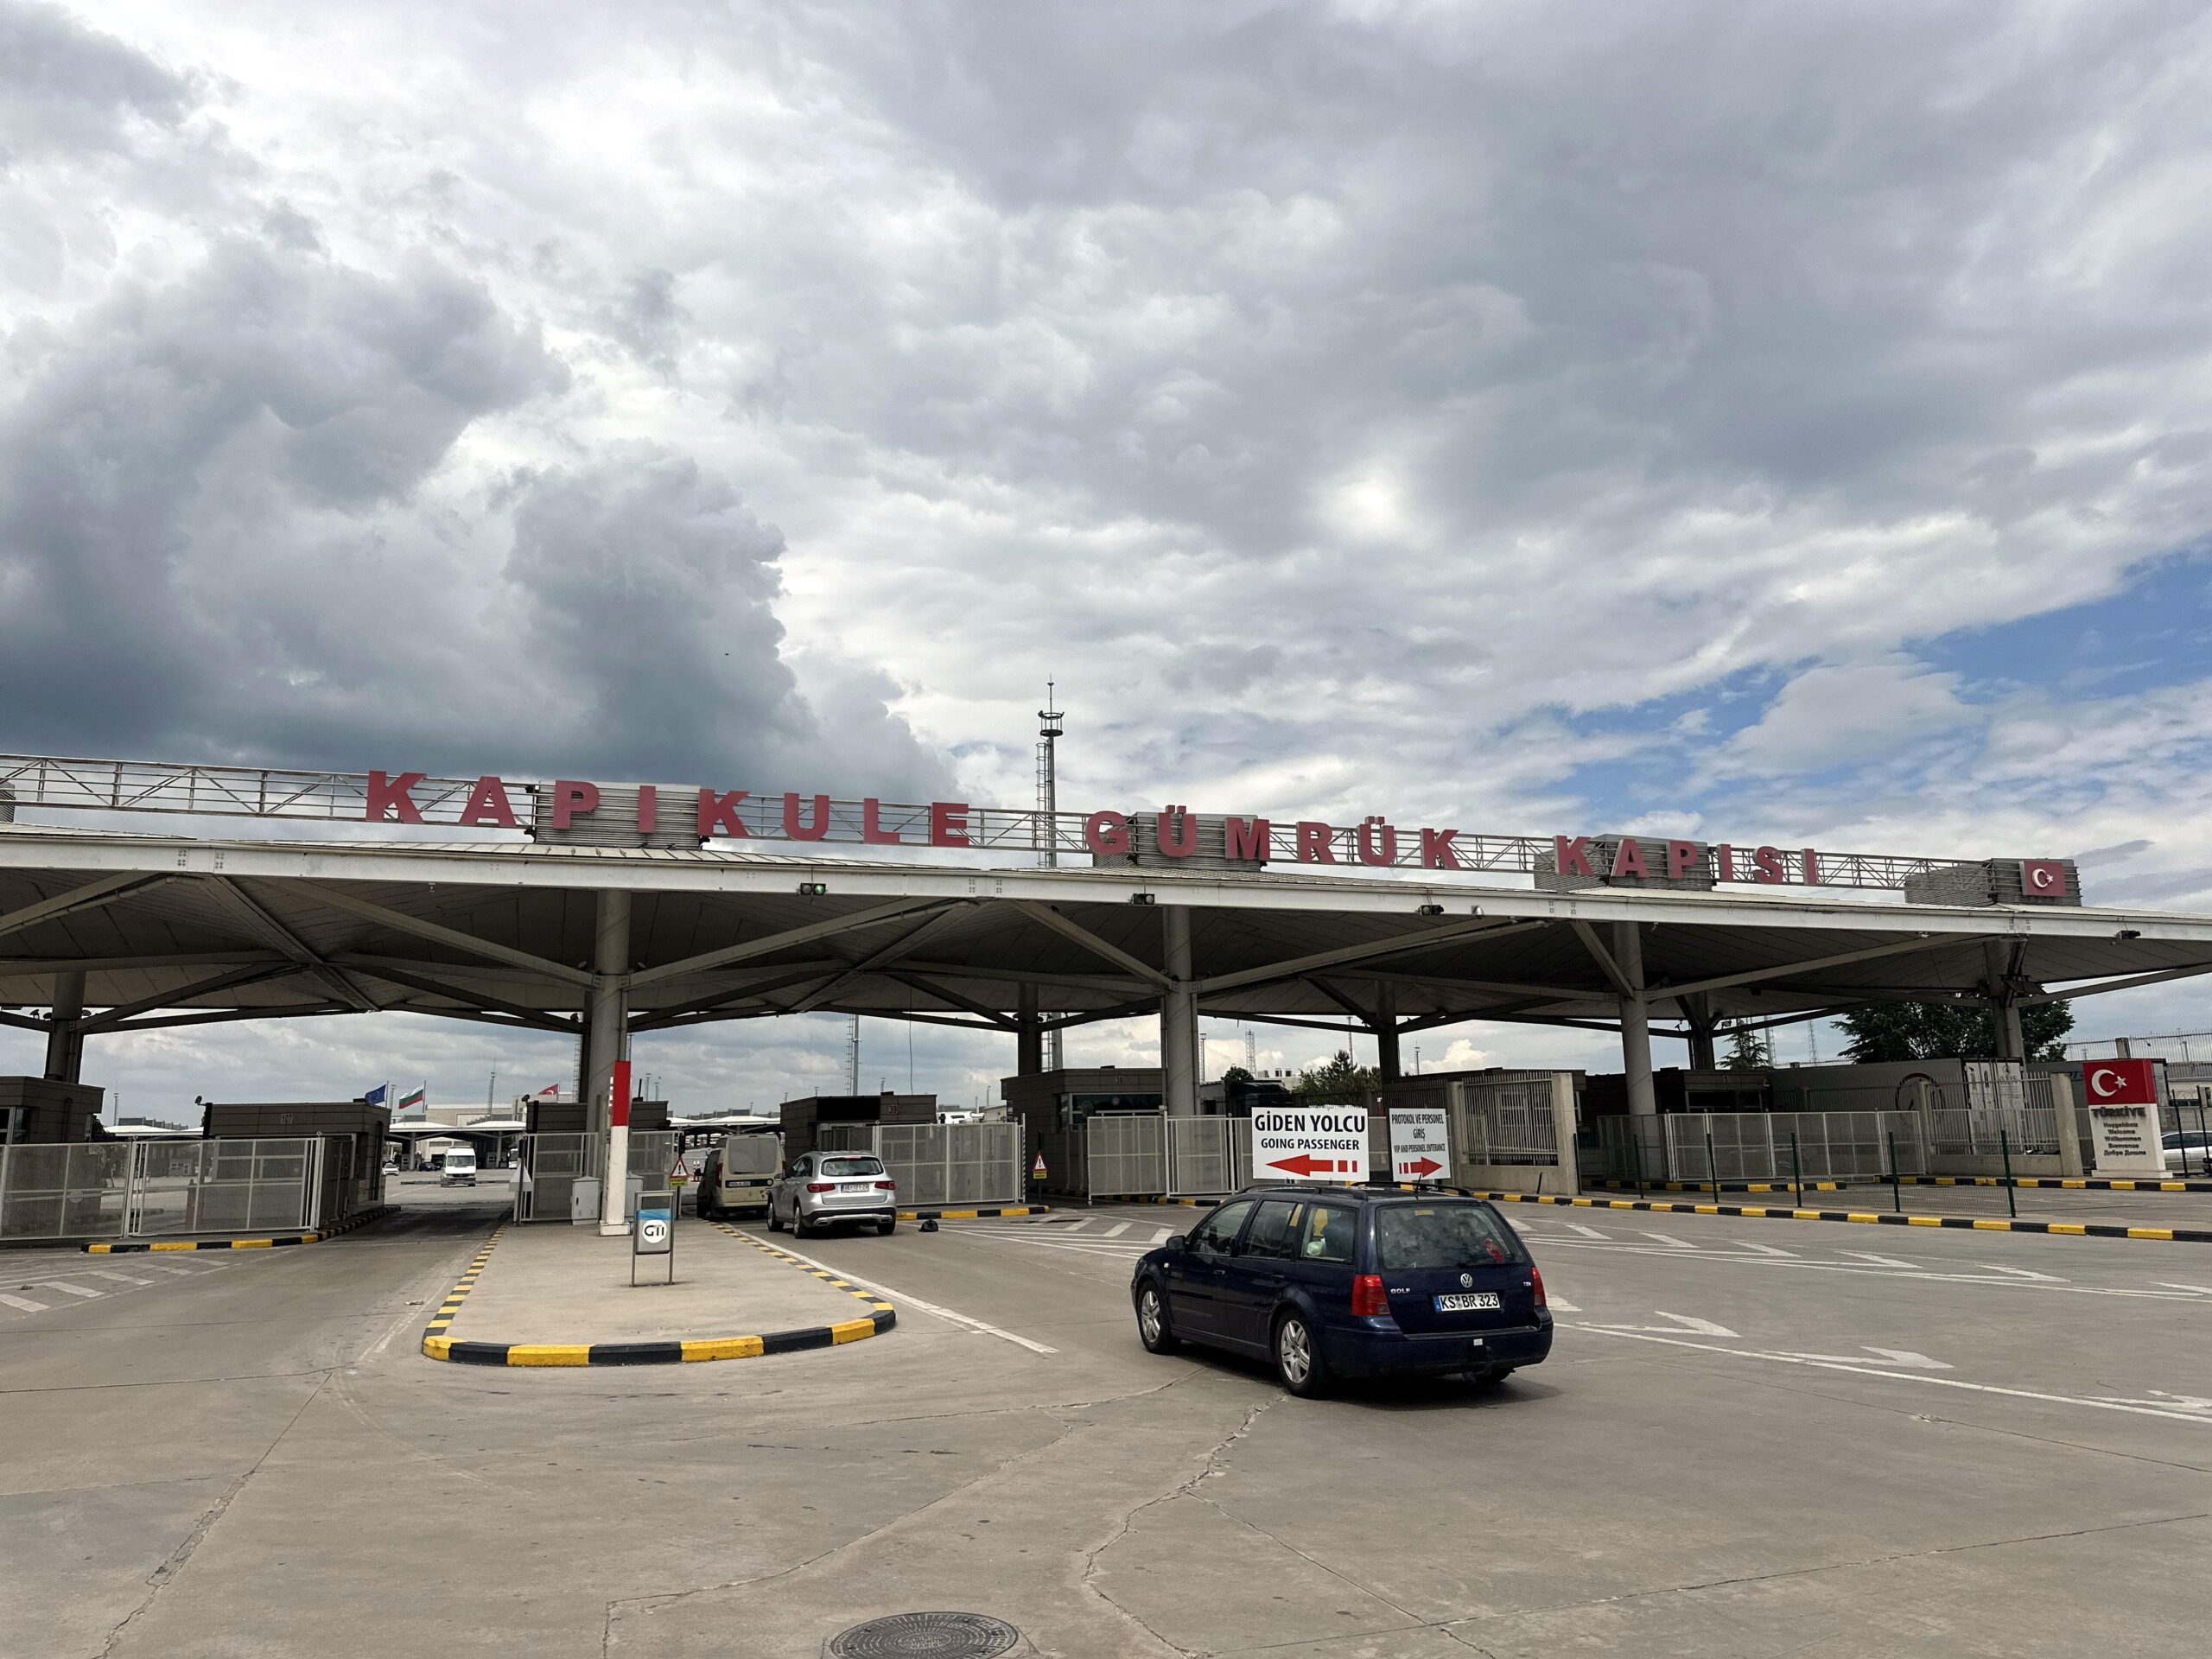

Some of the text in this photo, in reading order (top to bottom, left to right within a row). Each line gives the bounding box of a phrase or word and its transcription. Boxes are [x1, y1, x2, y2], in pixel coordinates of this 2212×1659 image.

[365, 770, 1819, 885] KAPIKULE GÜMRÜK KAPISI
[2091, 1106, 2146, 1118] TÜRKİYE
[1255, 1110, 1365, 1133] GİDEN YOLCU
[1392, 1114, 1444, 1124] PROTOKOL VE PERSONEL
[1262, 1138, 1359, 1150] GOING PASSENGER
[1479, 1294, 1498, 1306] 323
